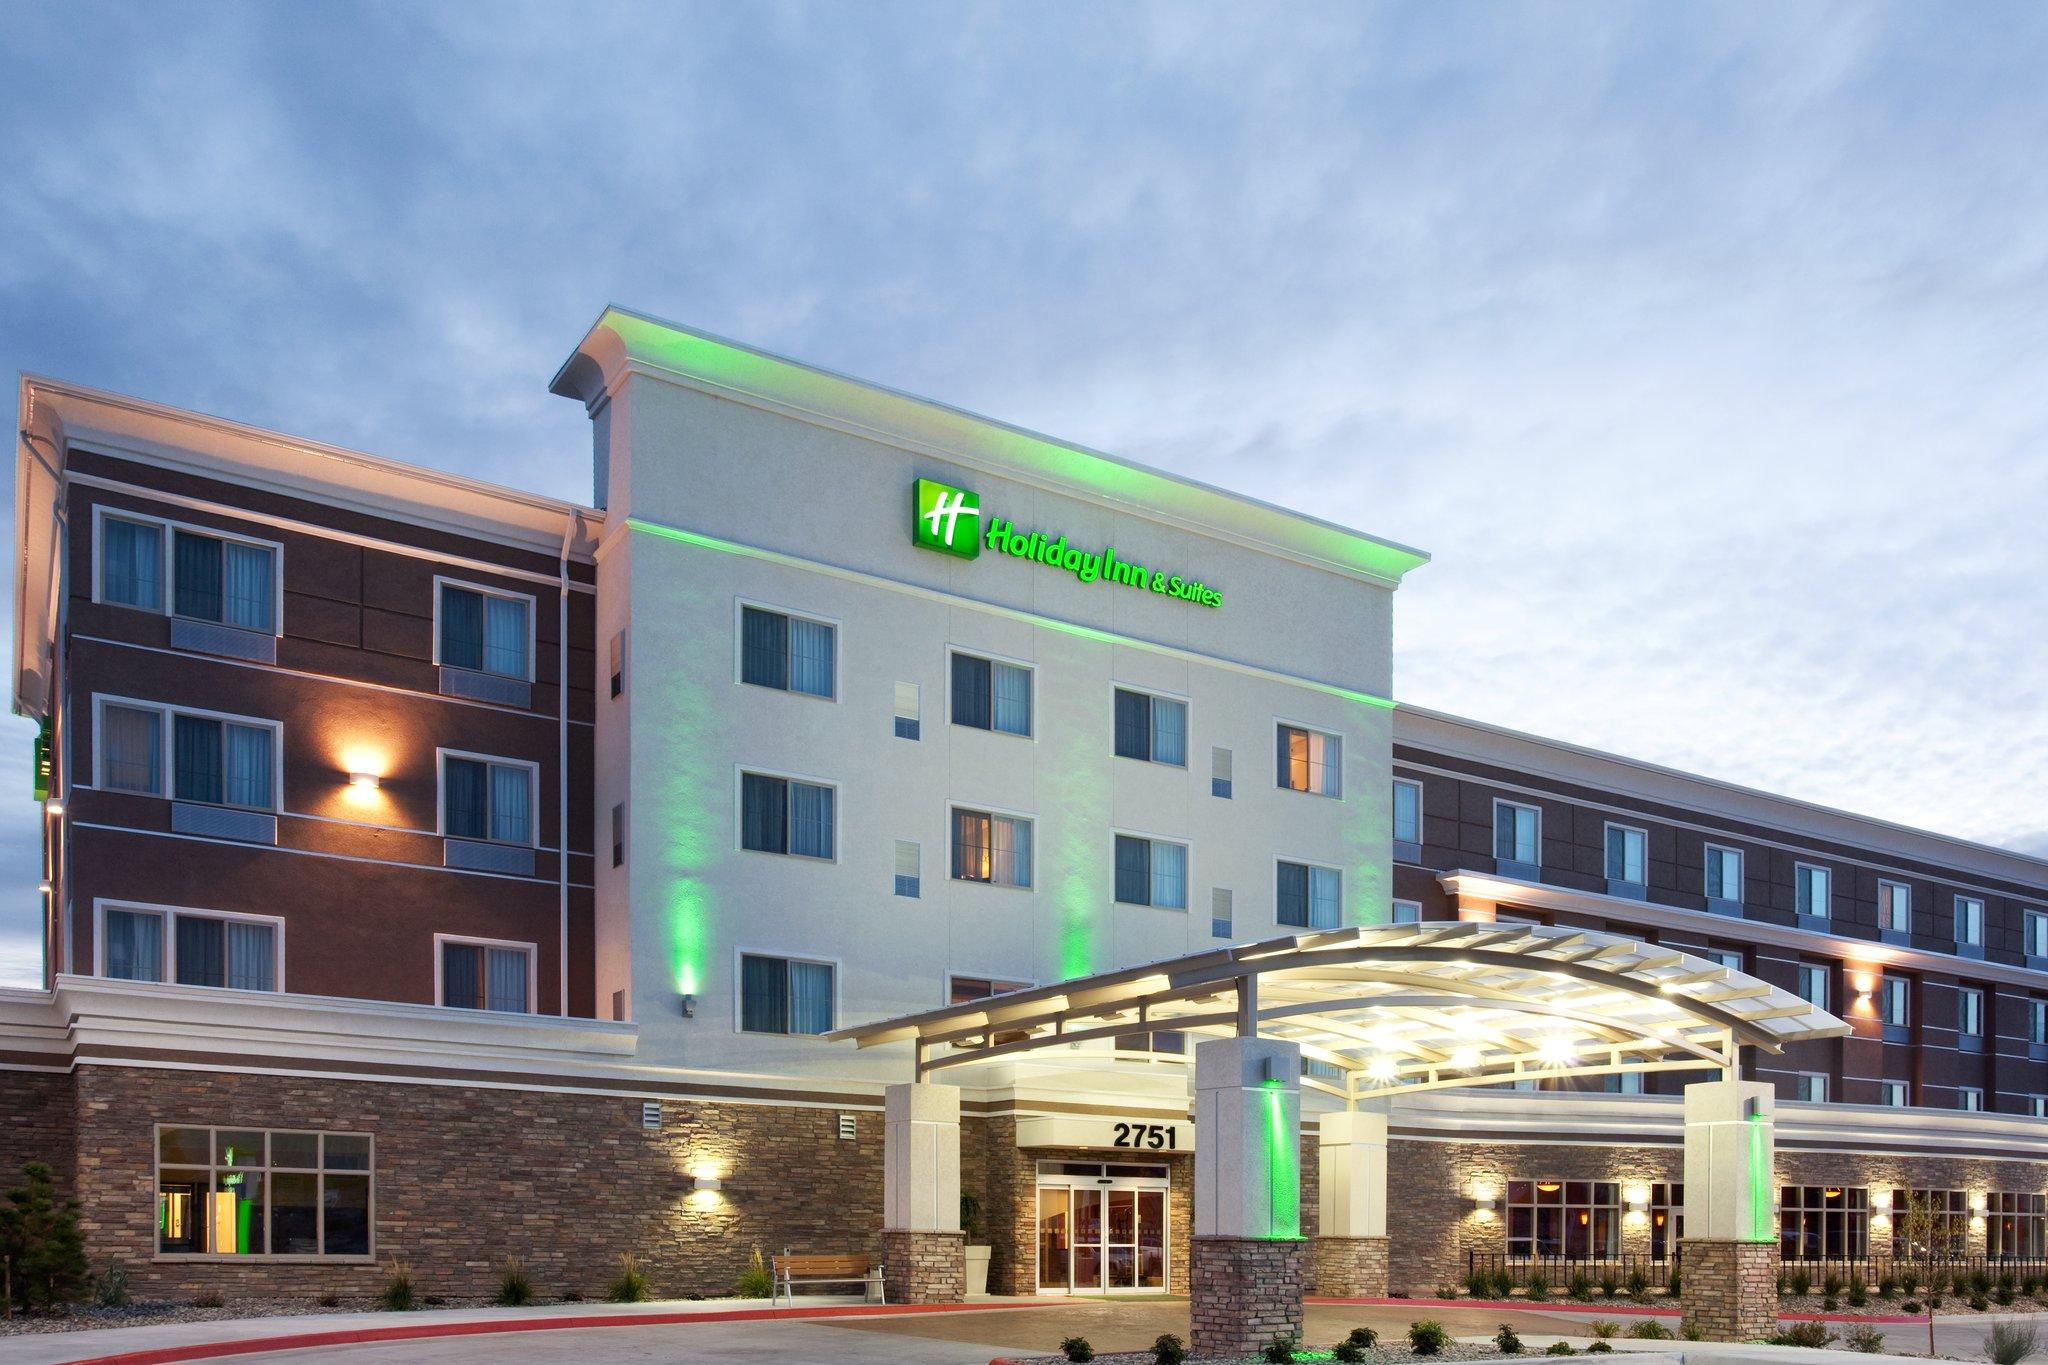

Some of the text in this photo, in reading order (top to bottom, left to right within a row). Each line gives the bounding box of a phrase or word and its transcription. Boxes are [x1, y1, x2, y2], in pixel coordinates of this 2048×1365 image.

[985, 516, 1224, 609] Holiday Inn & Suites
[1113, 1122, 1176, 1150] 2751
